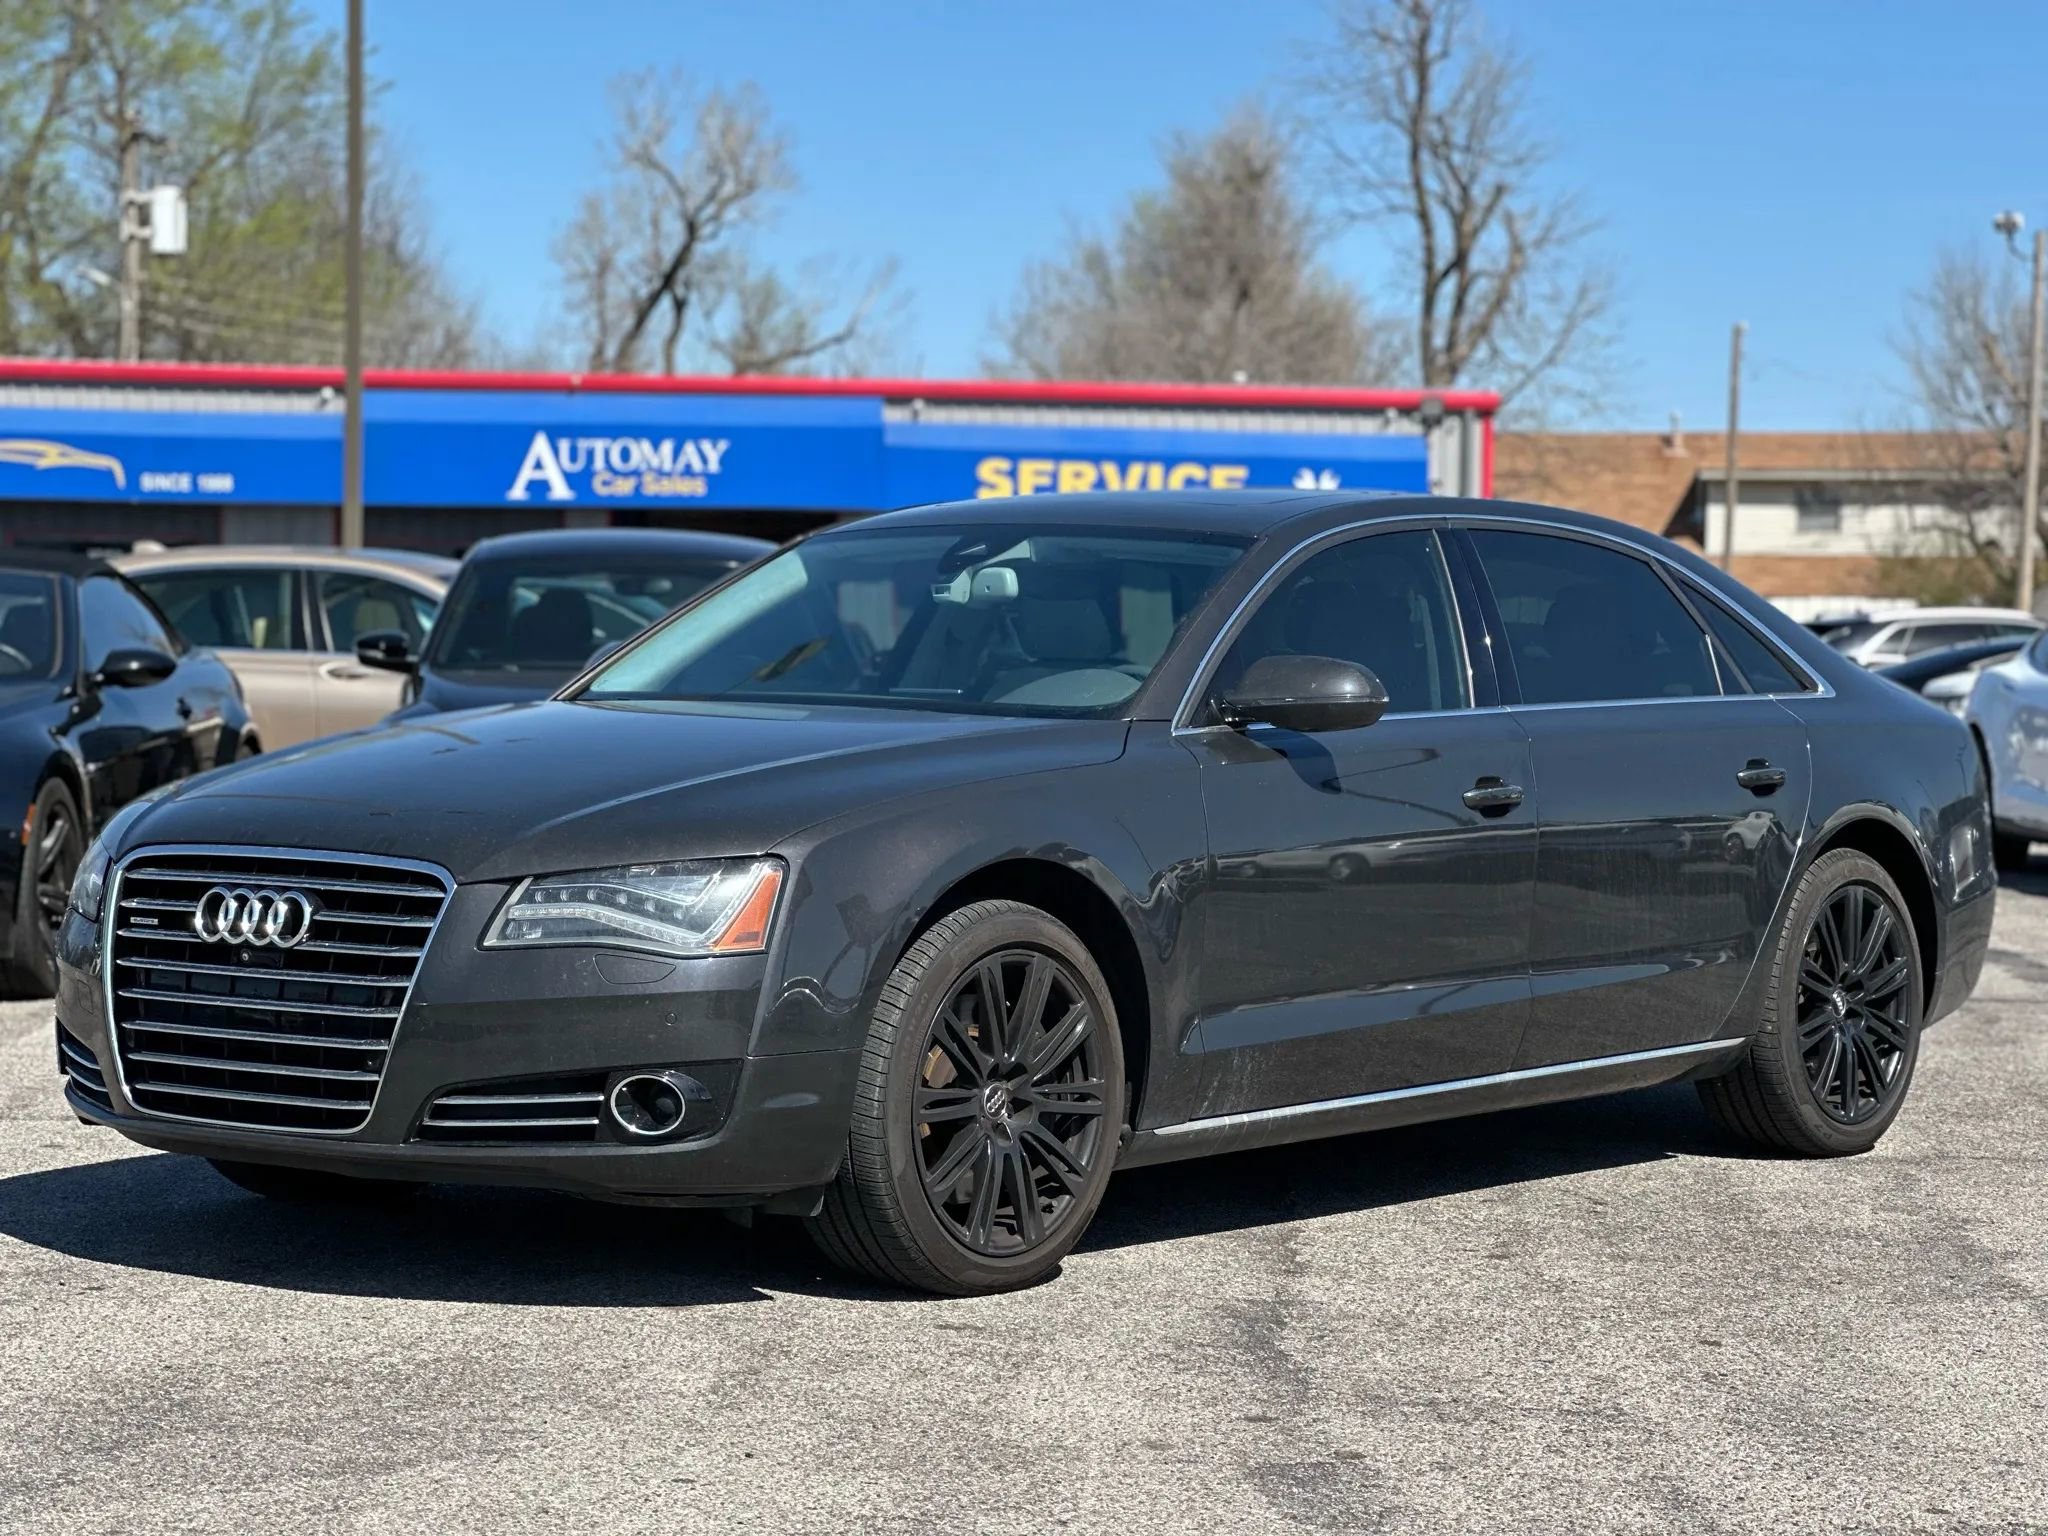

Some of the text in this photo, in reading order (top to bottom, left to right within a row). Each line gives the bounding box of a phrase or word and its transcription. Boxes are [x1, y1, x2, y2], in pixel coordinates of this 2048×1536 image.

[140, 471, 193, 493] SINCE
[505, 430, 731, 500] AUTOMAY
[975, 457, 1249, 499] SERVICE
[592, 470, 709, 497] Car Sales
